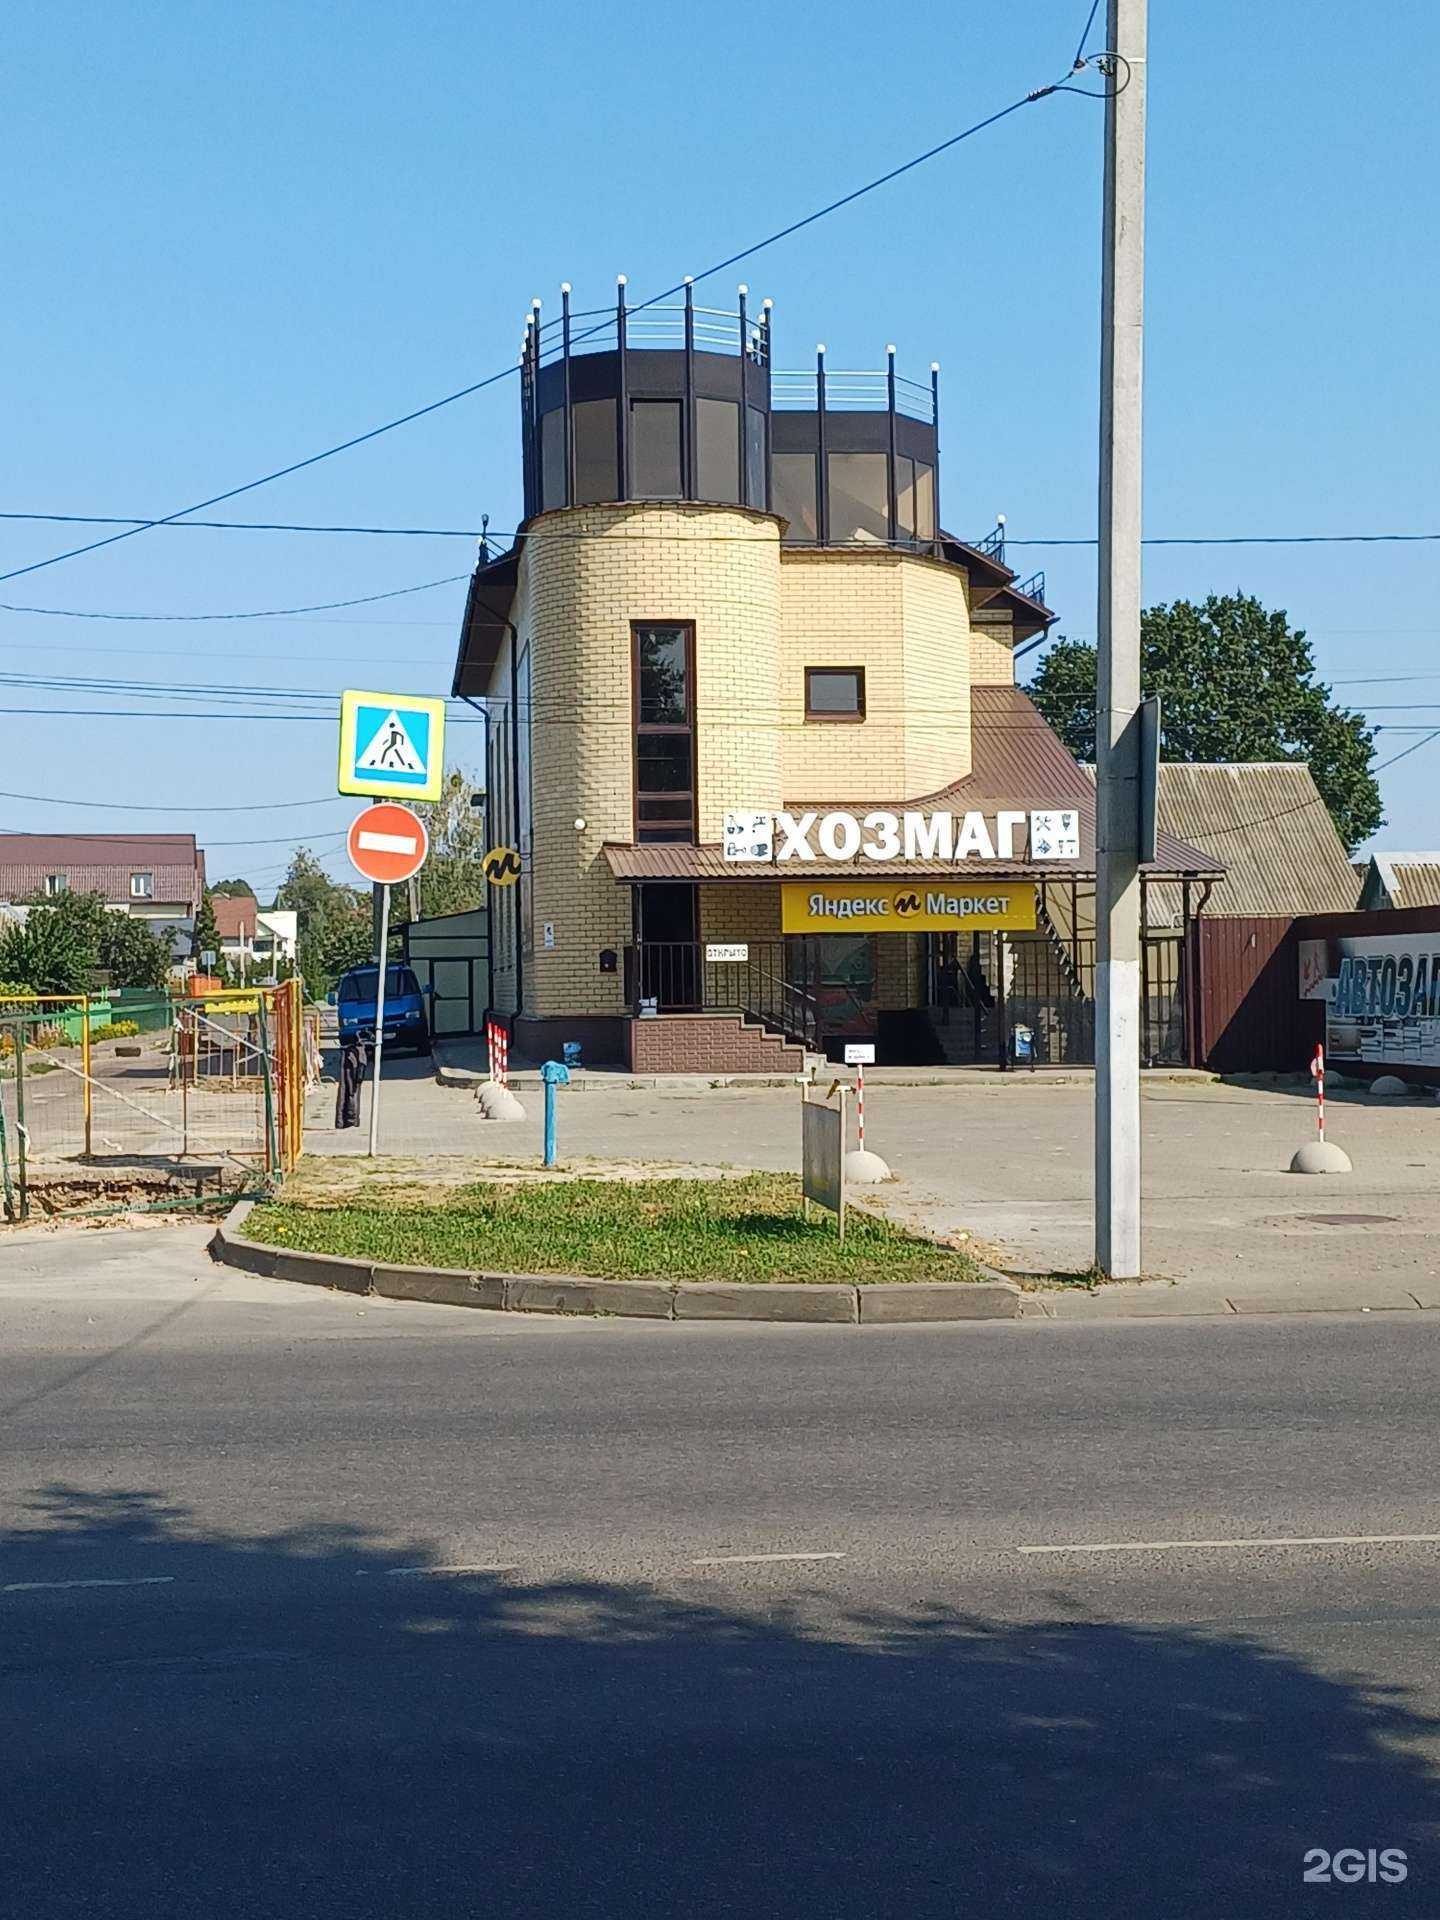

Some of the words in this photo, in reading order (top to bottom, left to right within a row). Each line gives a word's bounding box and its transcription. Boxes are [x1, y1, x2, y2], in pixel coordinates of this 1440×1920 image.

[776, 810, 1026, 861] ХОЗМАГ
[808, 894, 889, 917] Яндекс
[926, 893, 1010, 917] Маркет
